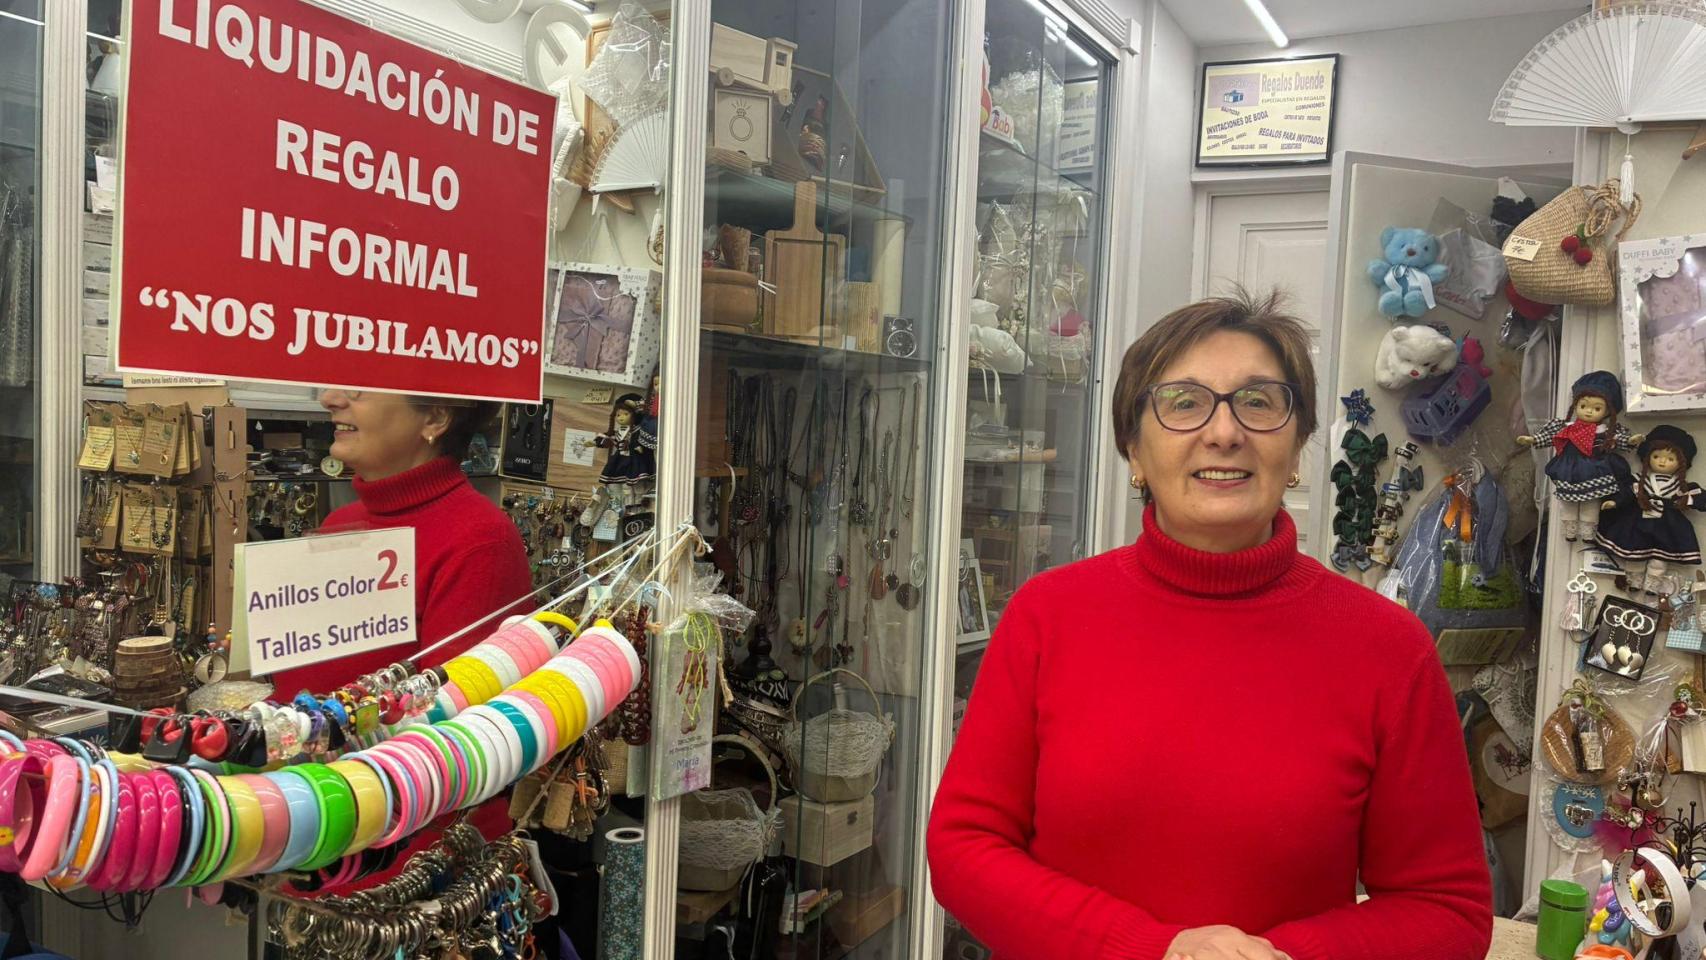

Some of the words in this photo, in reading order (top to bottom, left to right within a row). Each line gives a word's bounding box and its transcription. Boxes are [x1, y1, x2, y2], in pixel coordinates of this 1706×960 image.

[158, 0, 480, 137] LIQUIDACIÓN
[492, 100, 540, 155] DE
[1261, 72, 1293, 98] Regalos
[1294, 70, 1325, 91] Duende
[1206, 117, 1244, 135] INVITACIONES
[1244, 114, 1253, 124] DE
[1252, 110, 1269, 122] BODA
[1258, 127, 1282, 139] REGALOS
[1282, 131, 1297, 141] PARA
[1296, 133, 1325, 146] INVITADOS
[275, 119, 460, 211] REGALO
[240, 207, 478, 298] INFORMAL
[1651, 247, 1676, 257] BABY
[139, 286, 275, 341] “NOS
[286, 307, 539, 368] JUBILAMOS”
[248, 584, 320, 613] Anillos
[325, 575, 376, 600] Color
[256, 630, 322, 661] Tallas
[327, 613, 409, 647] Surtidas
